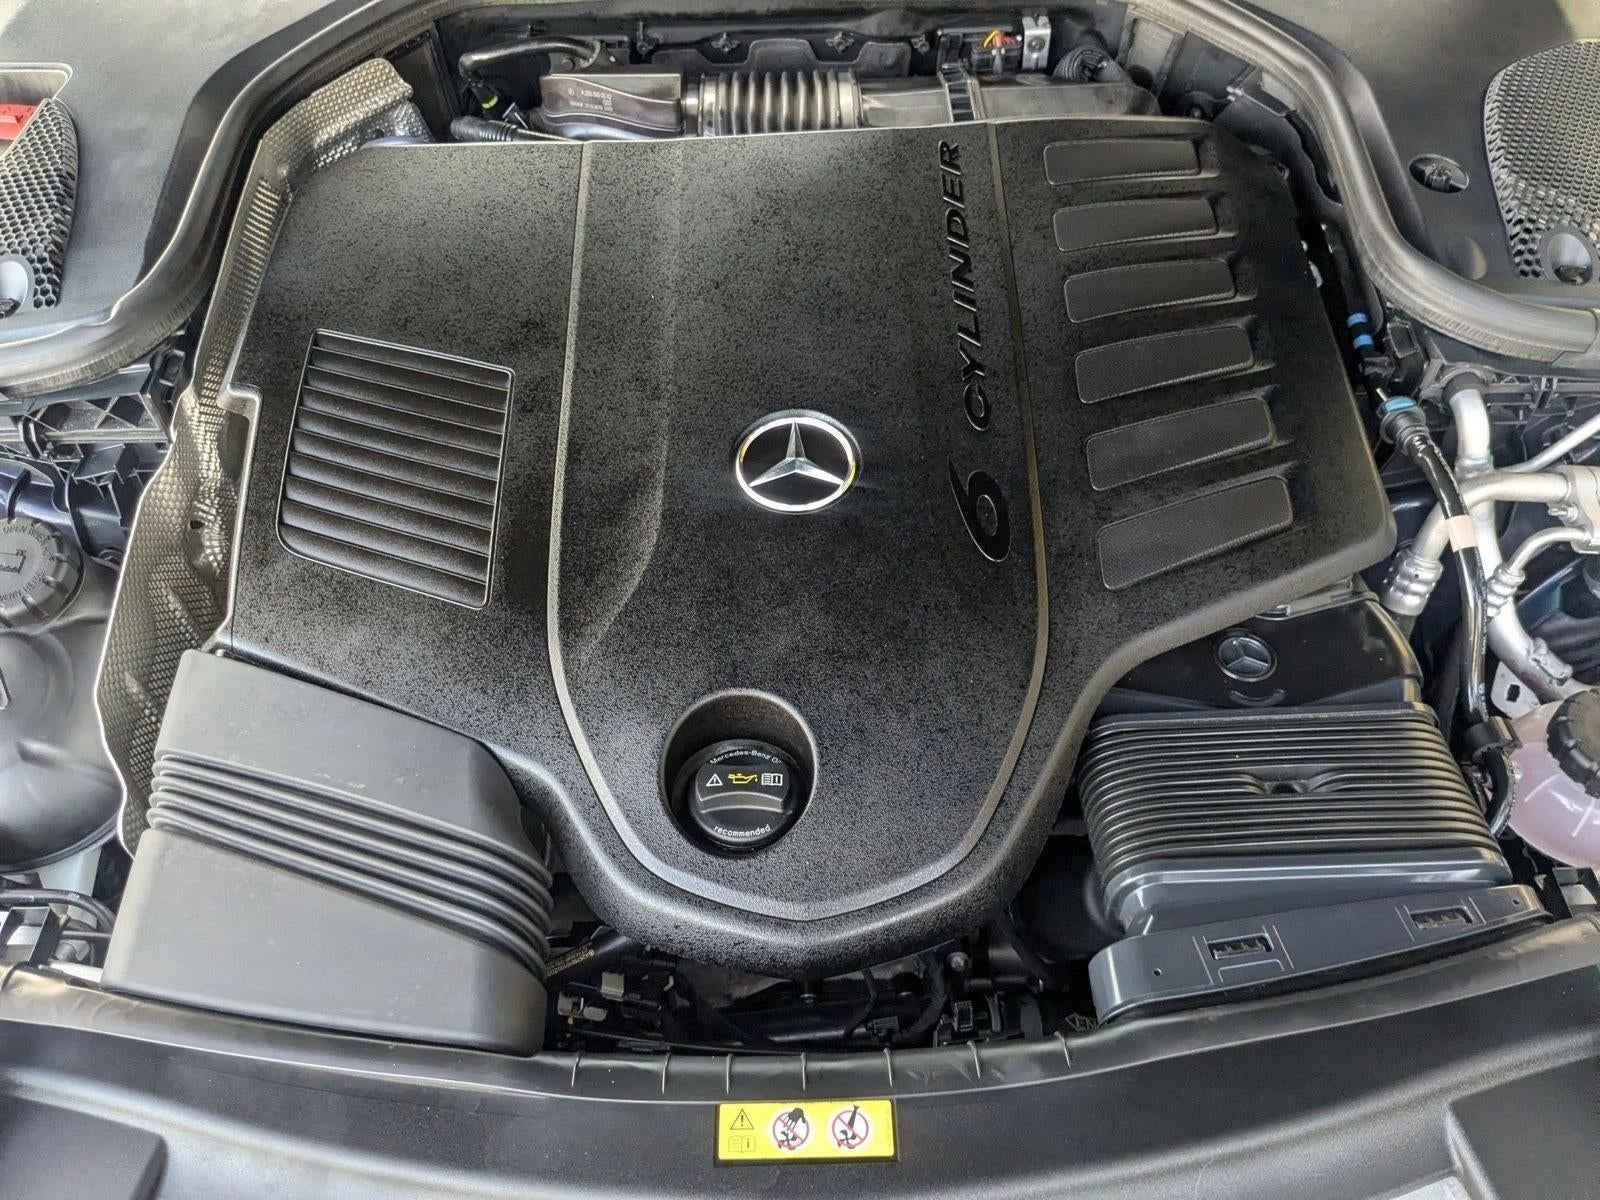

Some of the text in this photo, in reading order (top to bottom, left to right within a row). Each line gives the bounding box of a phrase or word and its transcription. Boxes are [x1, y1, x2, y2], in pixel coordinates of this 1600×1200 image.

[939, 140, 1011, 562] 6 CYLINDER
[709, 750, 770, 764] Mercedes-Benz
[714, 823, 771, 837] recommended
